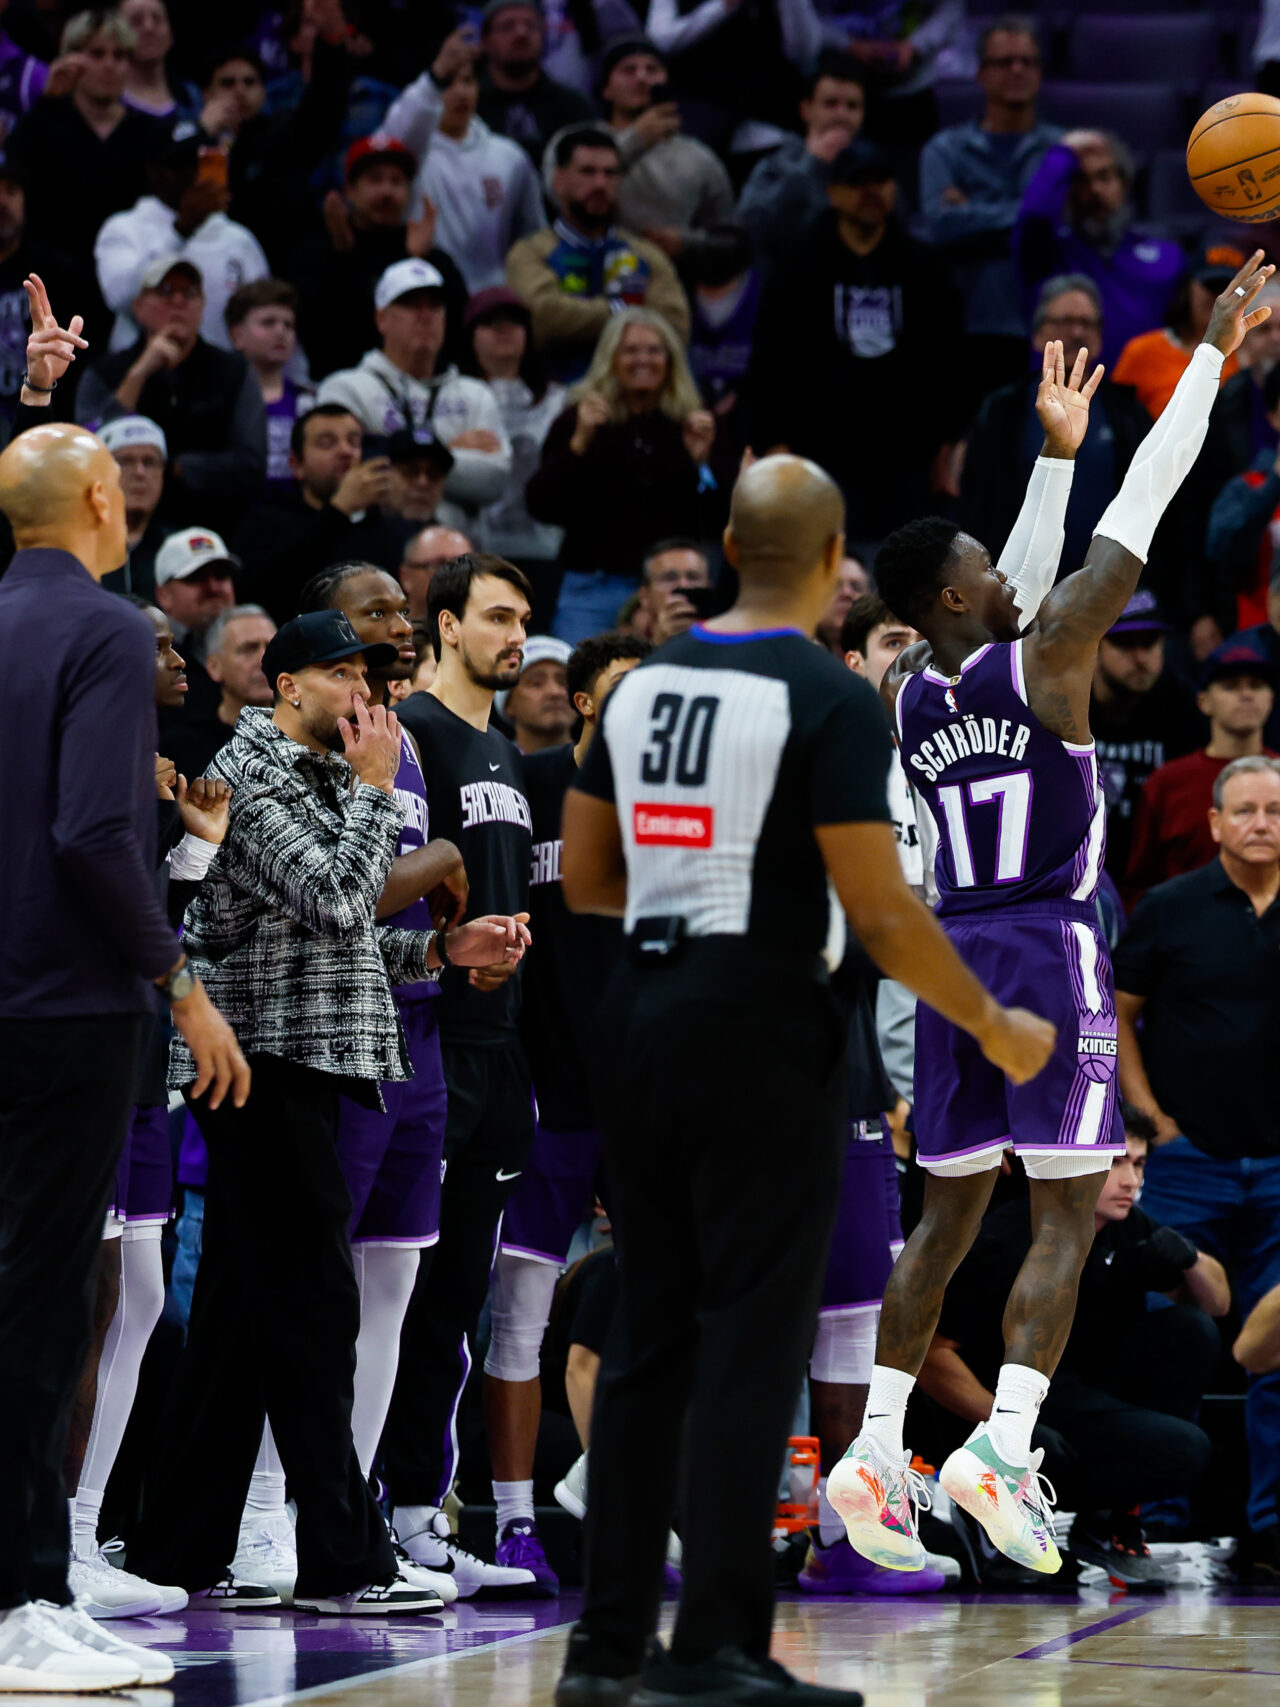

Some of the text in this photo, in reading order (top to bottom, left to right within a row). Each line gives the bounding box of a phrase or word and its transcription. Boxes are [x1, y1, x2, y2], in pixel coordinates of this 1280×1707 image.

[640, 693, 721, 788] 30
[909, 713, 1031, 782] SCHRÖDER
[636, 811, 706, 839] Emirates
[936, 768, 1035, 889] 17
[1077, 1037, 1118, 1056] KINGS
